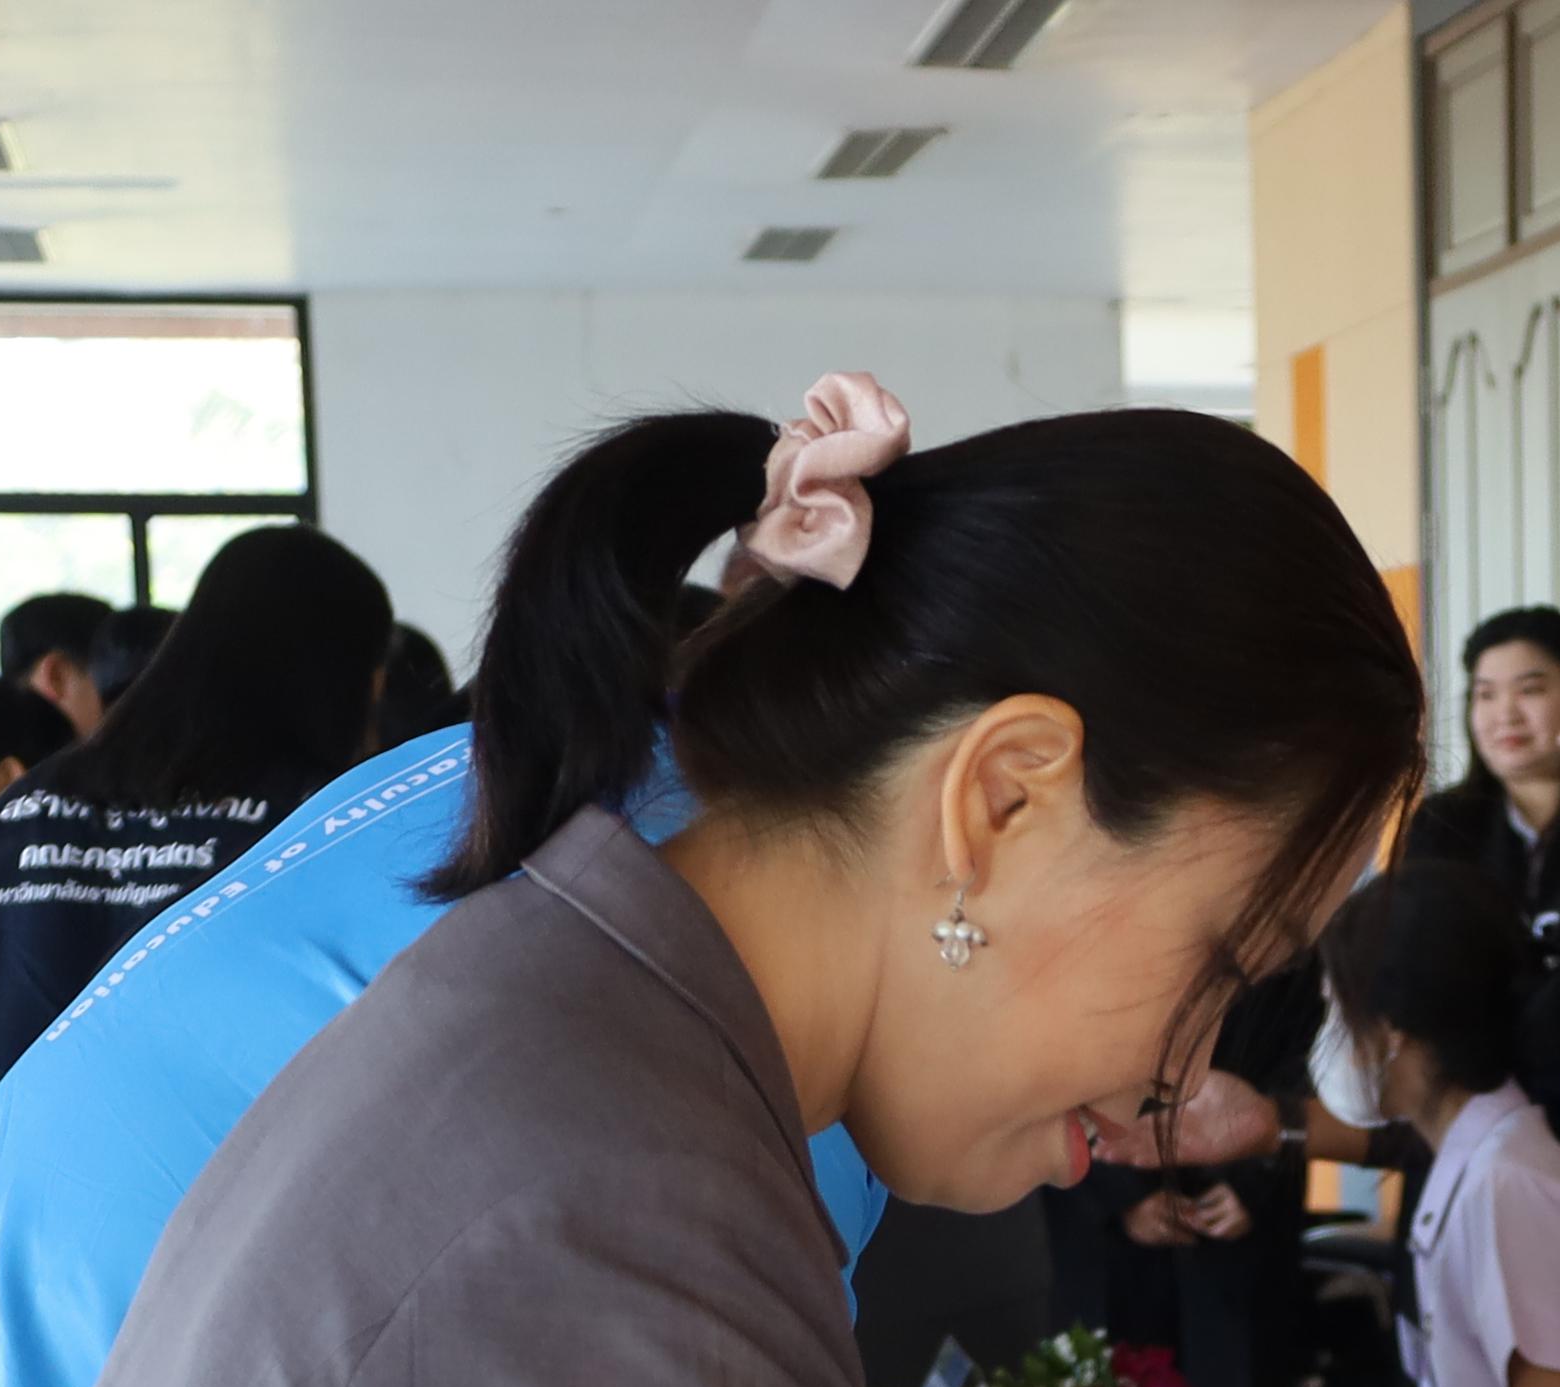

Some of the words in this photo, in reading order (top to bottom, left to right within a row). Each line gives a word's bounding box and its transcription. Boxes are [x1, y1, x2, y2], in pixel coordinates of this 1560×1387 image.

[18, 836, 220, 878] คณะครุศาสตร์
[264, 841, 308, 874] of
[45, 882, 248, 1042] Education
